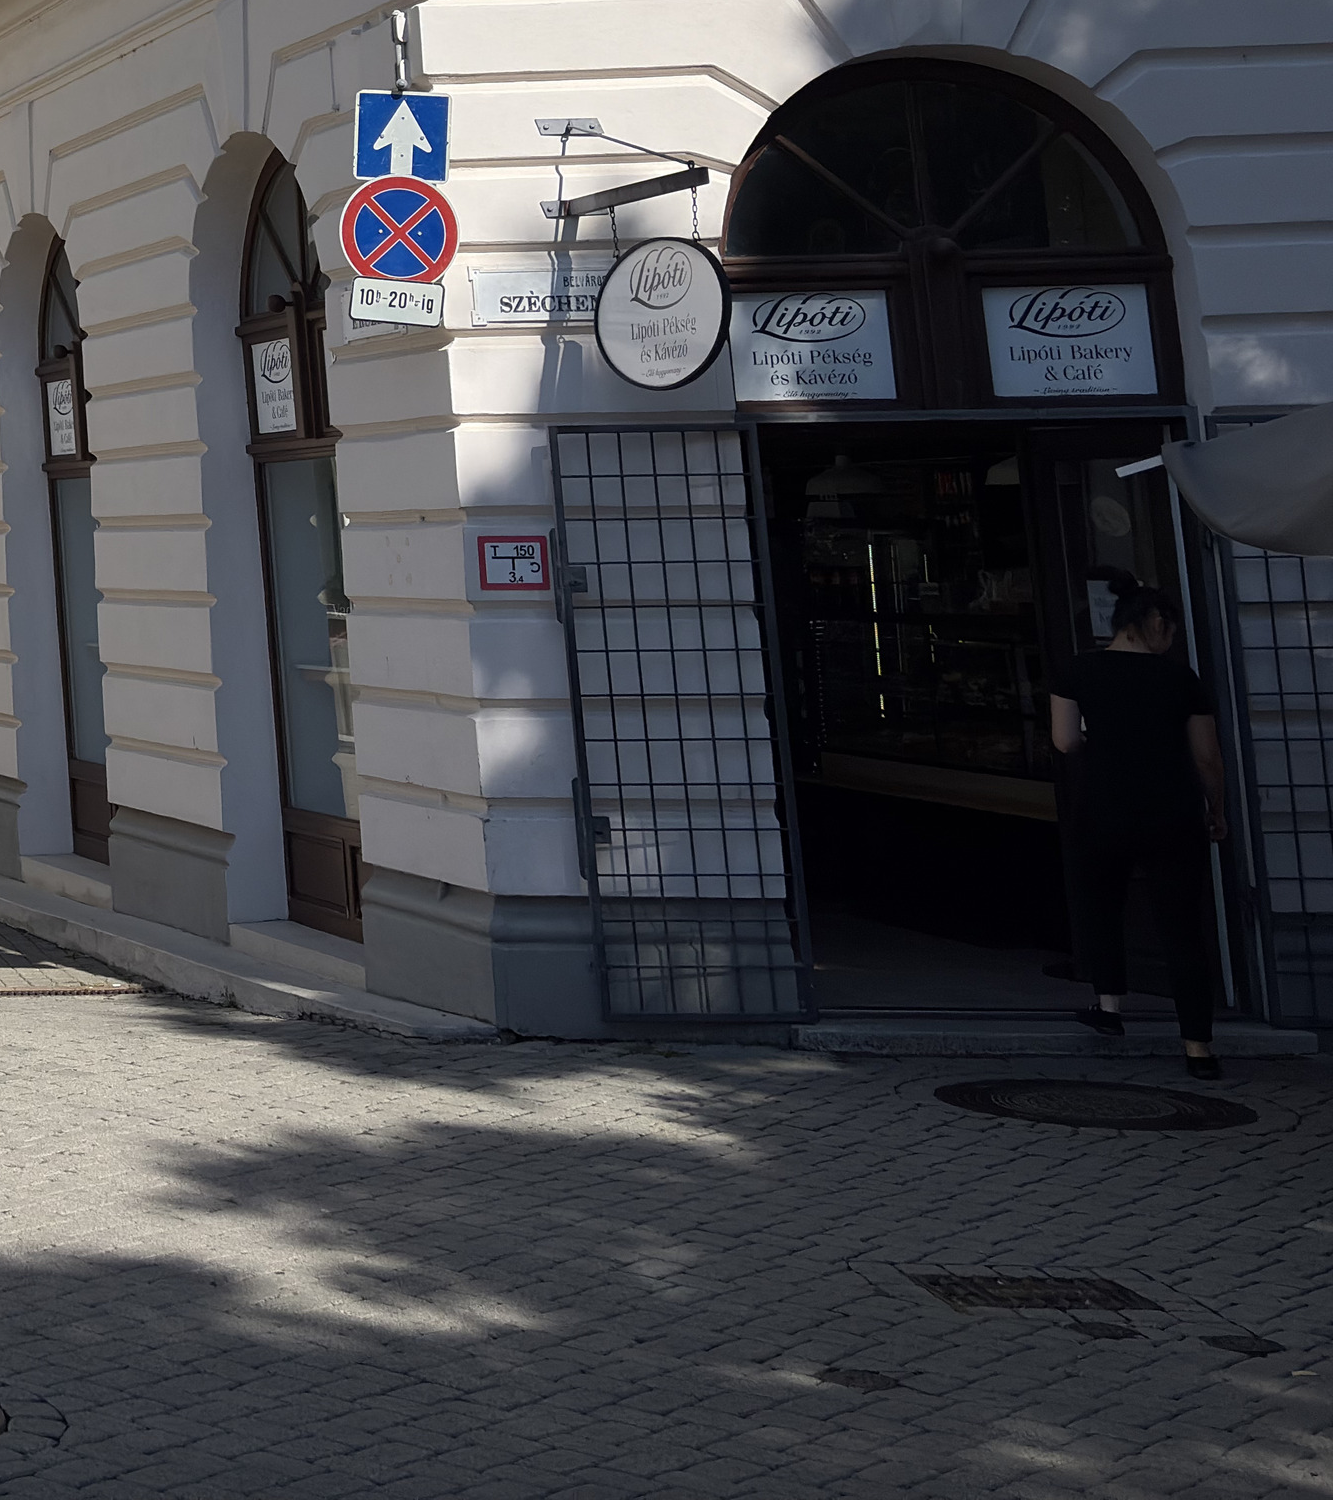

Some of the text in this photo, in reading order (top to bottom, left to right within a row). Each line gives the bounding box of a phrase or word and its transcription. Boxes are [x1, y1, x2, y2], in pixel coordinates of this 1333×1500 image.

[630, 246, 692, 309] Lipóti
[752, 293, 866, 343] Lipóti
[1008, 287, 1126, 338] Lipóti
[631, 313, 697, 343] Lipóti Pékség
[640, 339, 688, 363] és Kávézó
[752, 348, 873, 368] Lipóti Pékség
[1009, 344, 1132, 364] Lipóti Bakery
[770, 368, 858, 385] és Kávézó
[1044, 364, 1104, 381] & Café
[490, 544, 535, 556] T 150
